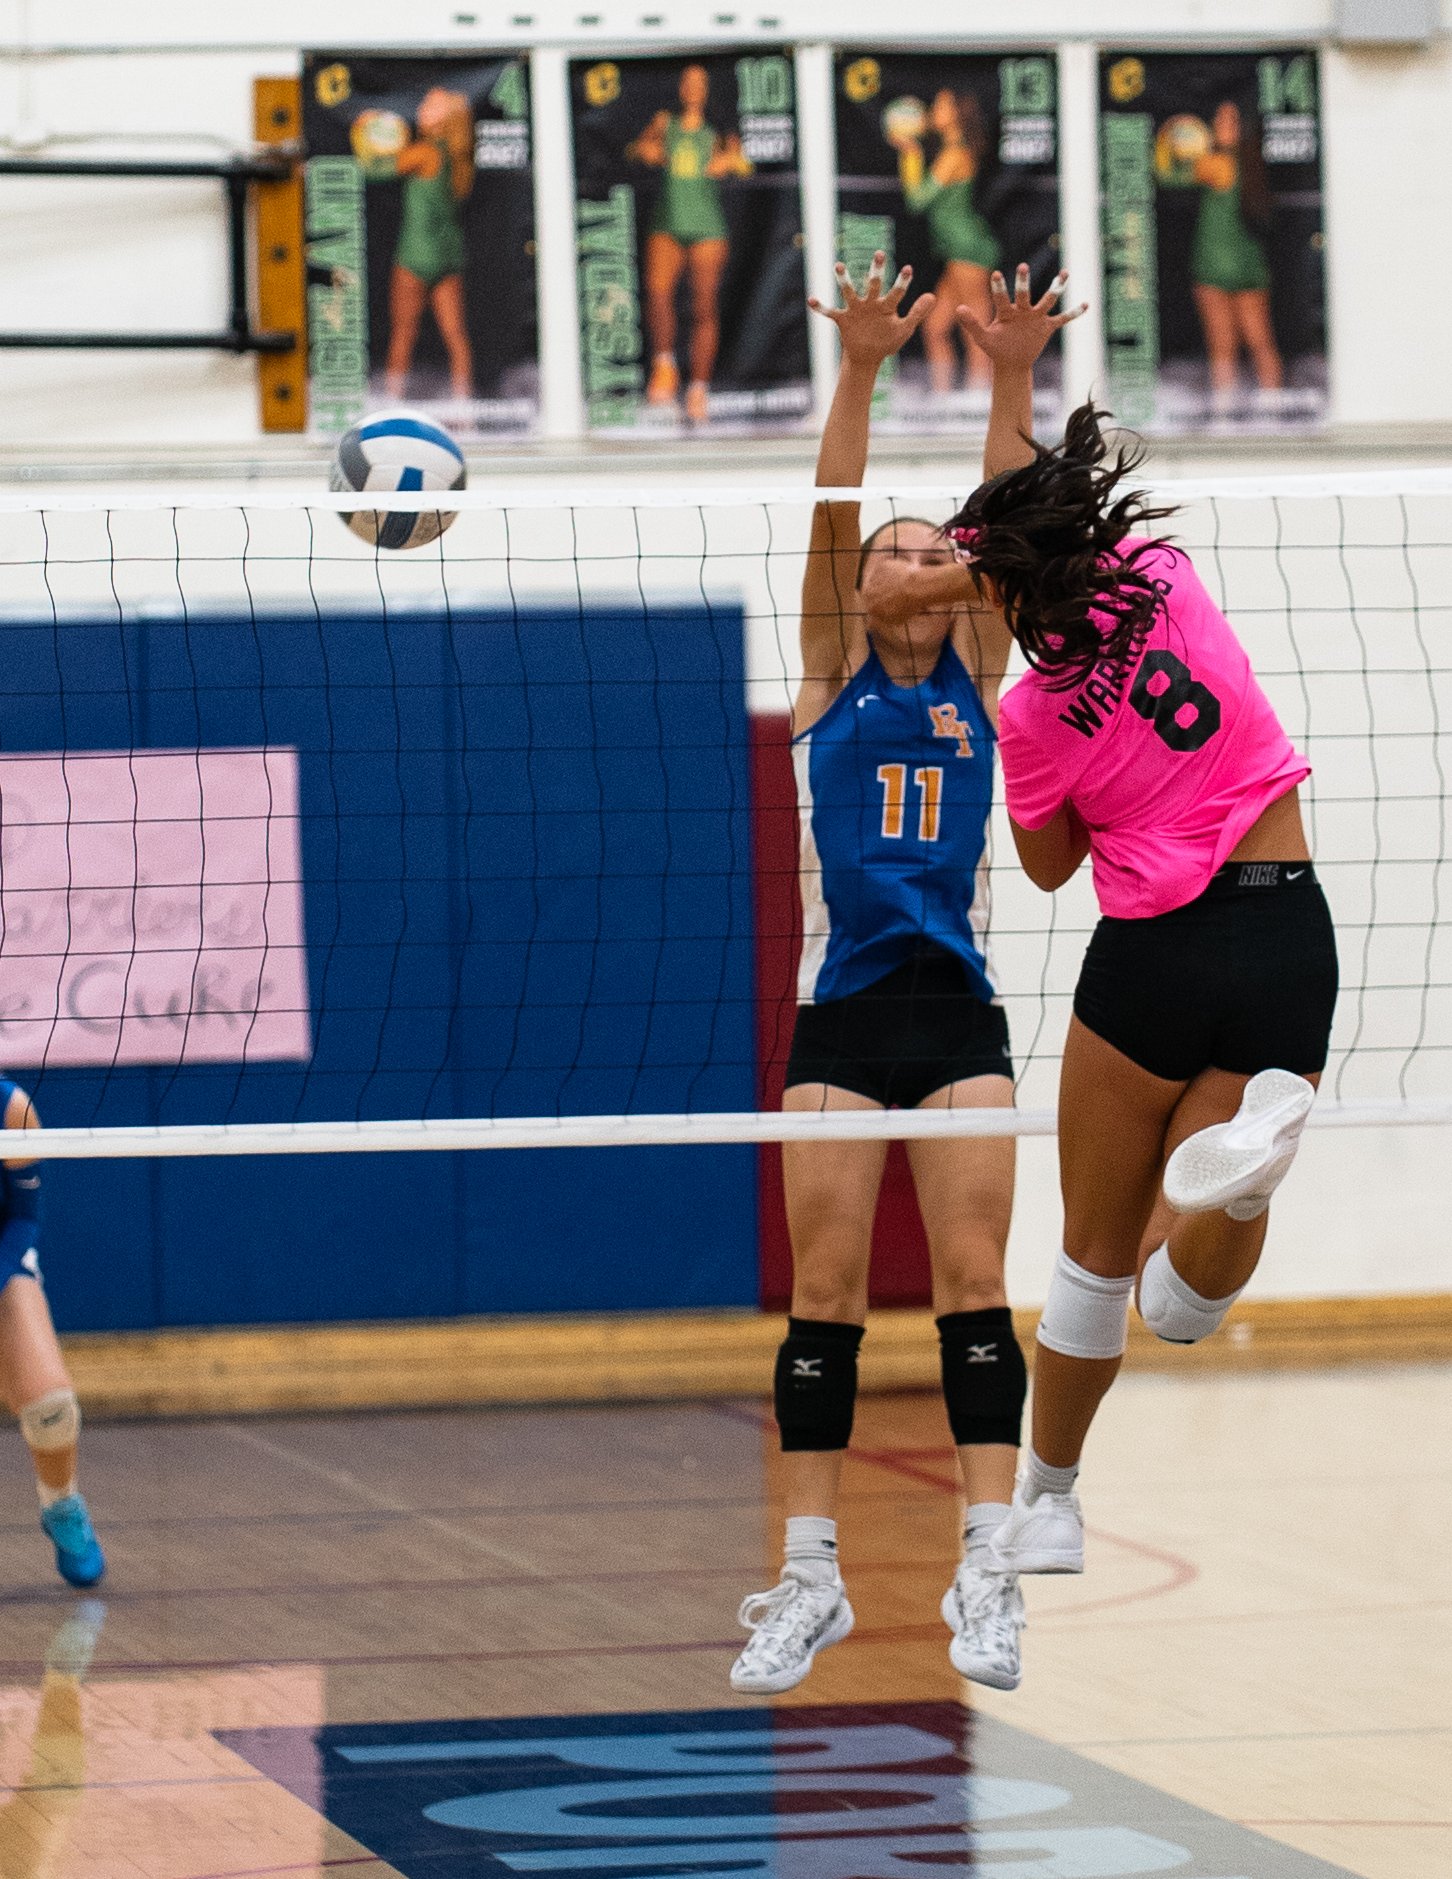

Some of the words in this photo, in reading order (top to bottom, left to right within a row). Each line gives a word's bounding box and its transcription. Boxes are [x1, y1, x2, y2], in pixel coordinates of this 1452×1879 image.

[488, 62, 528, 118] 4
[735, 56, 792, 114] 10
[1256, 56, 1315, 114] 14
[1128, 649, 1221, 752] 8
[876, 763, 944, 842] 11
[1238, 864, 1279, 886] NIKE
